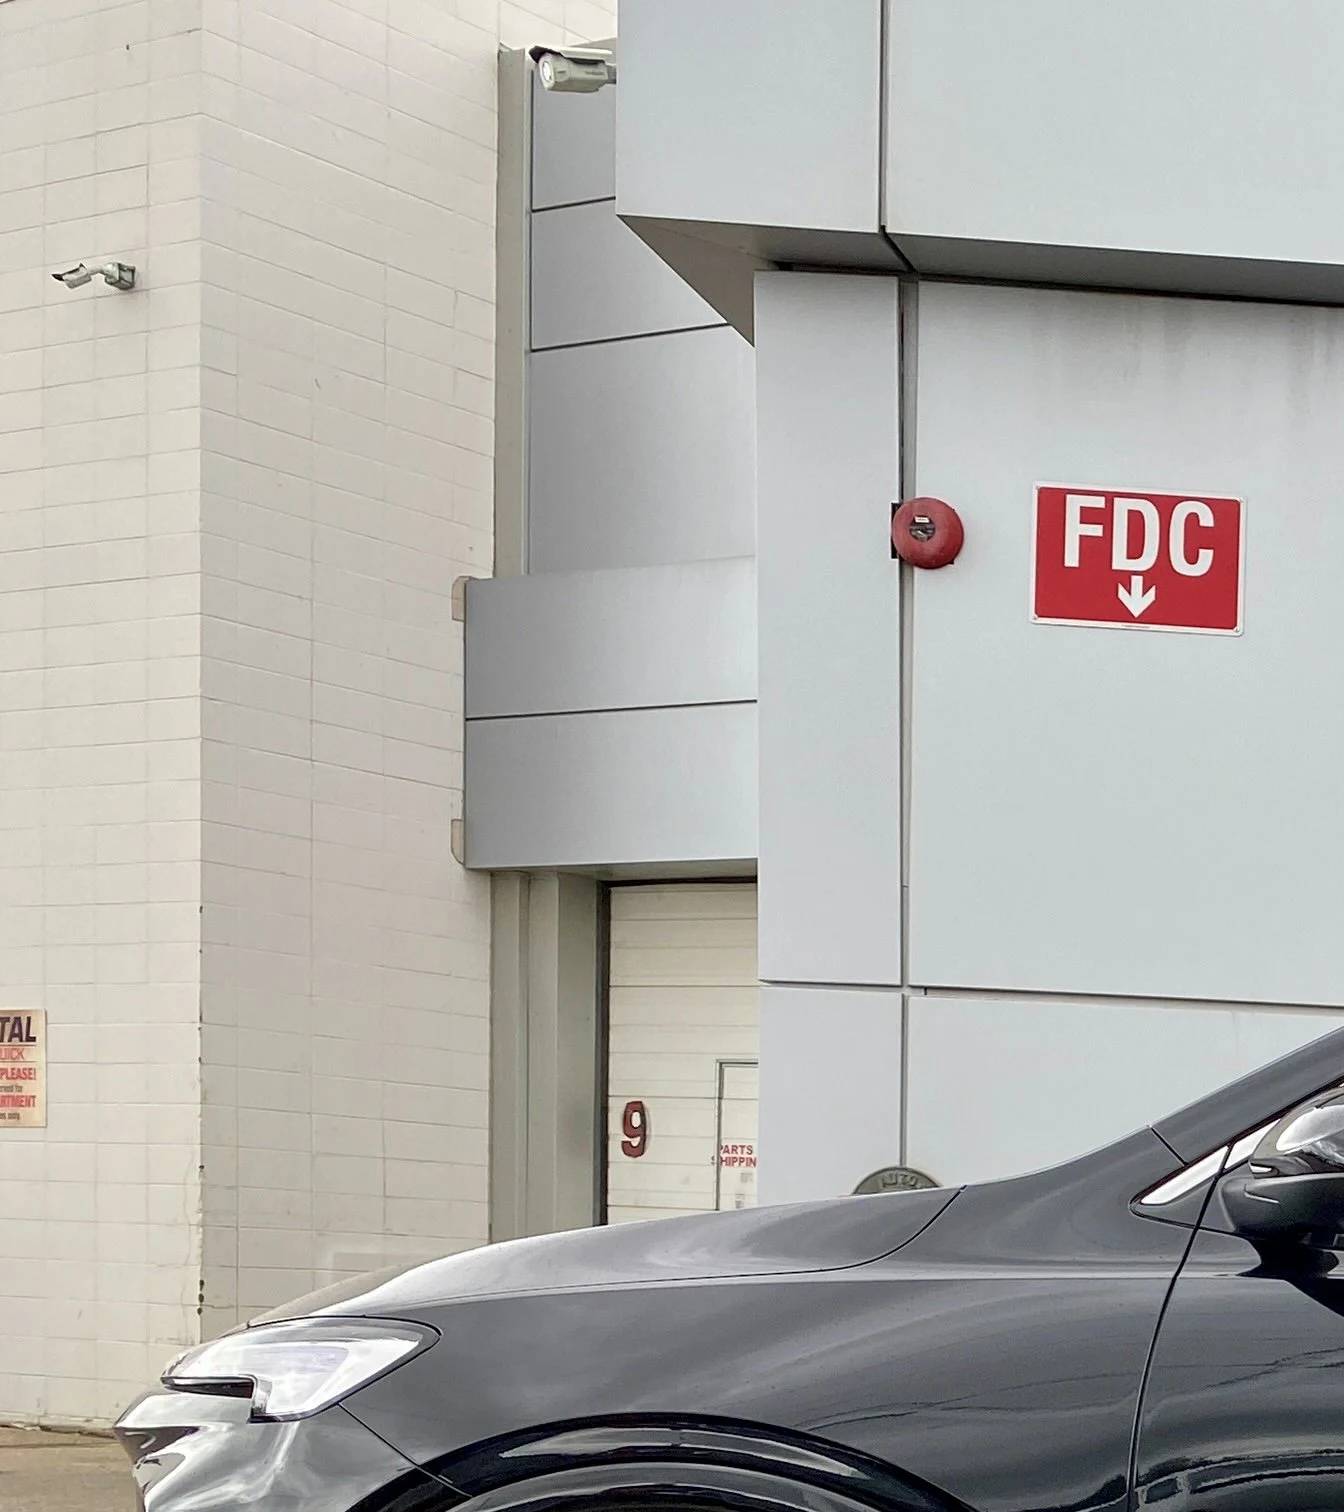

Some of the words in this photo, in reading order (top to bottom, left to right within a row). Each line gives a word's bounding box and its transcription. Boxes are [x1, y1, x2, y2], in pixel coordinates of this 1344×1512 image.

[1064, 494, 1214, 577] FDC
[621, 1100, 647, 1158] 9
[720, 1156, 757, 1168] HIPPIN
